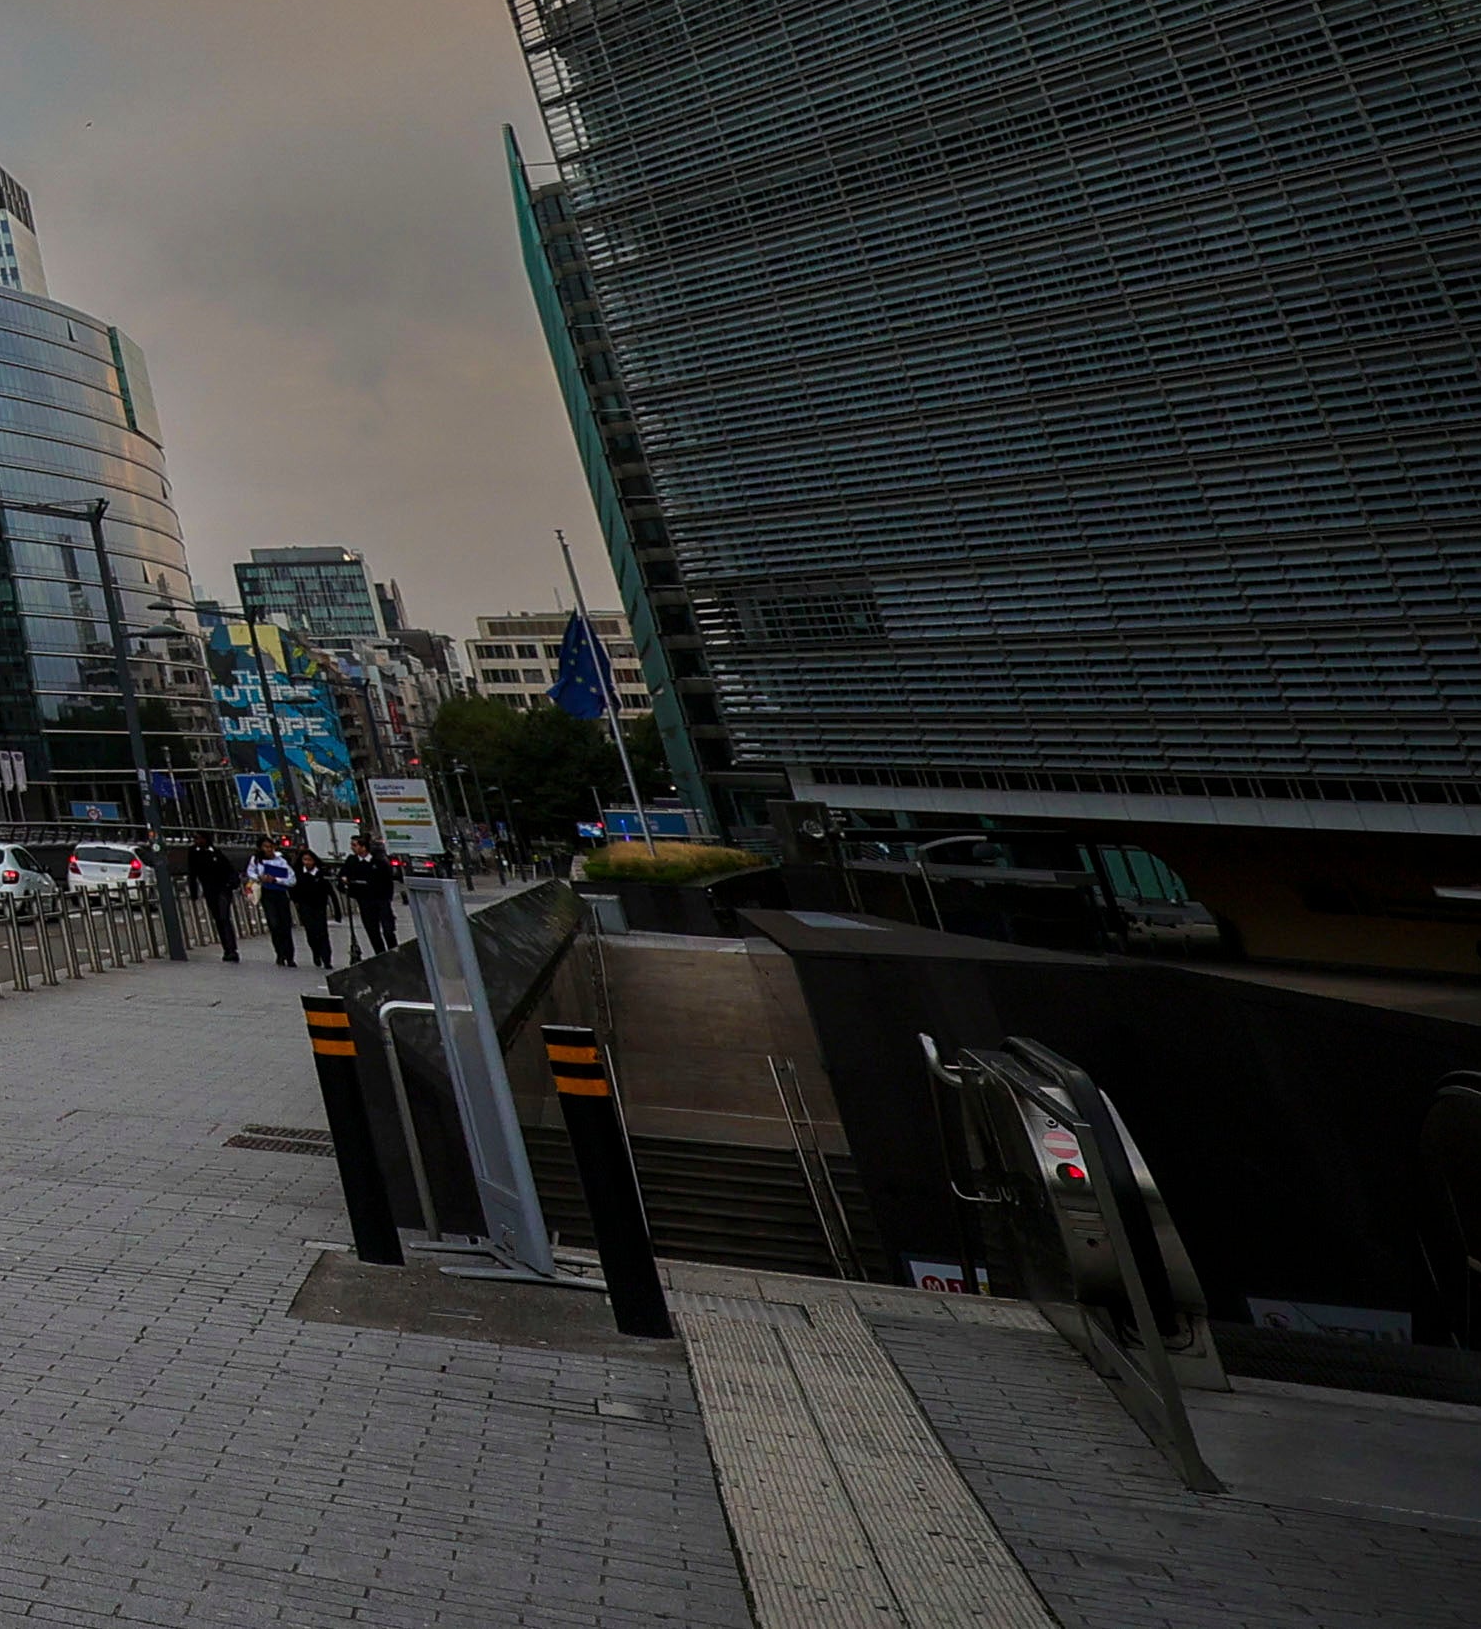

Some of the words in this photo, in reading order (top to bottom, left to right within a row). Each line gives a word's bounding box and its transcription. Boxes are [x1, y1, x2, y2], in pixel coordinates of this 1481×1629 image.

[231, 670, 278, 684] THE
[212, 684, 316, 703] UTURE
[219, 716, 330, 736] UROPE
